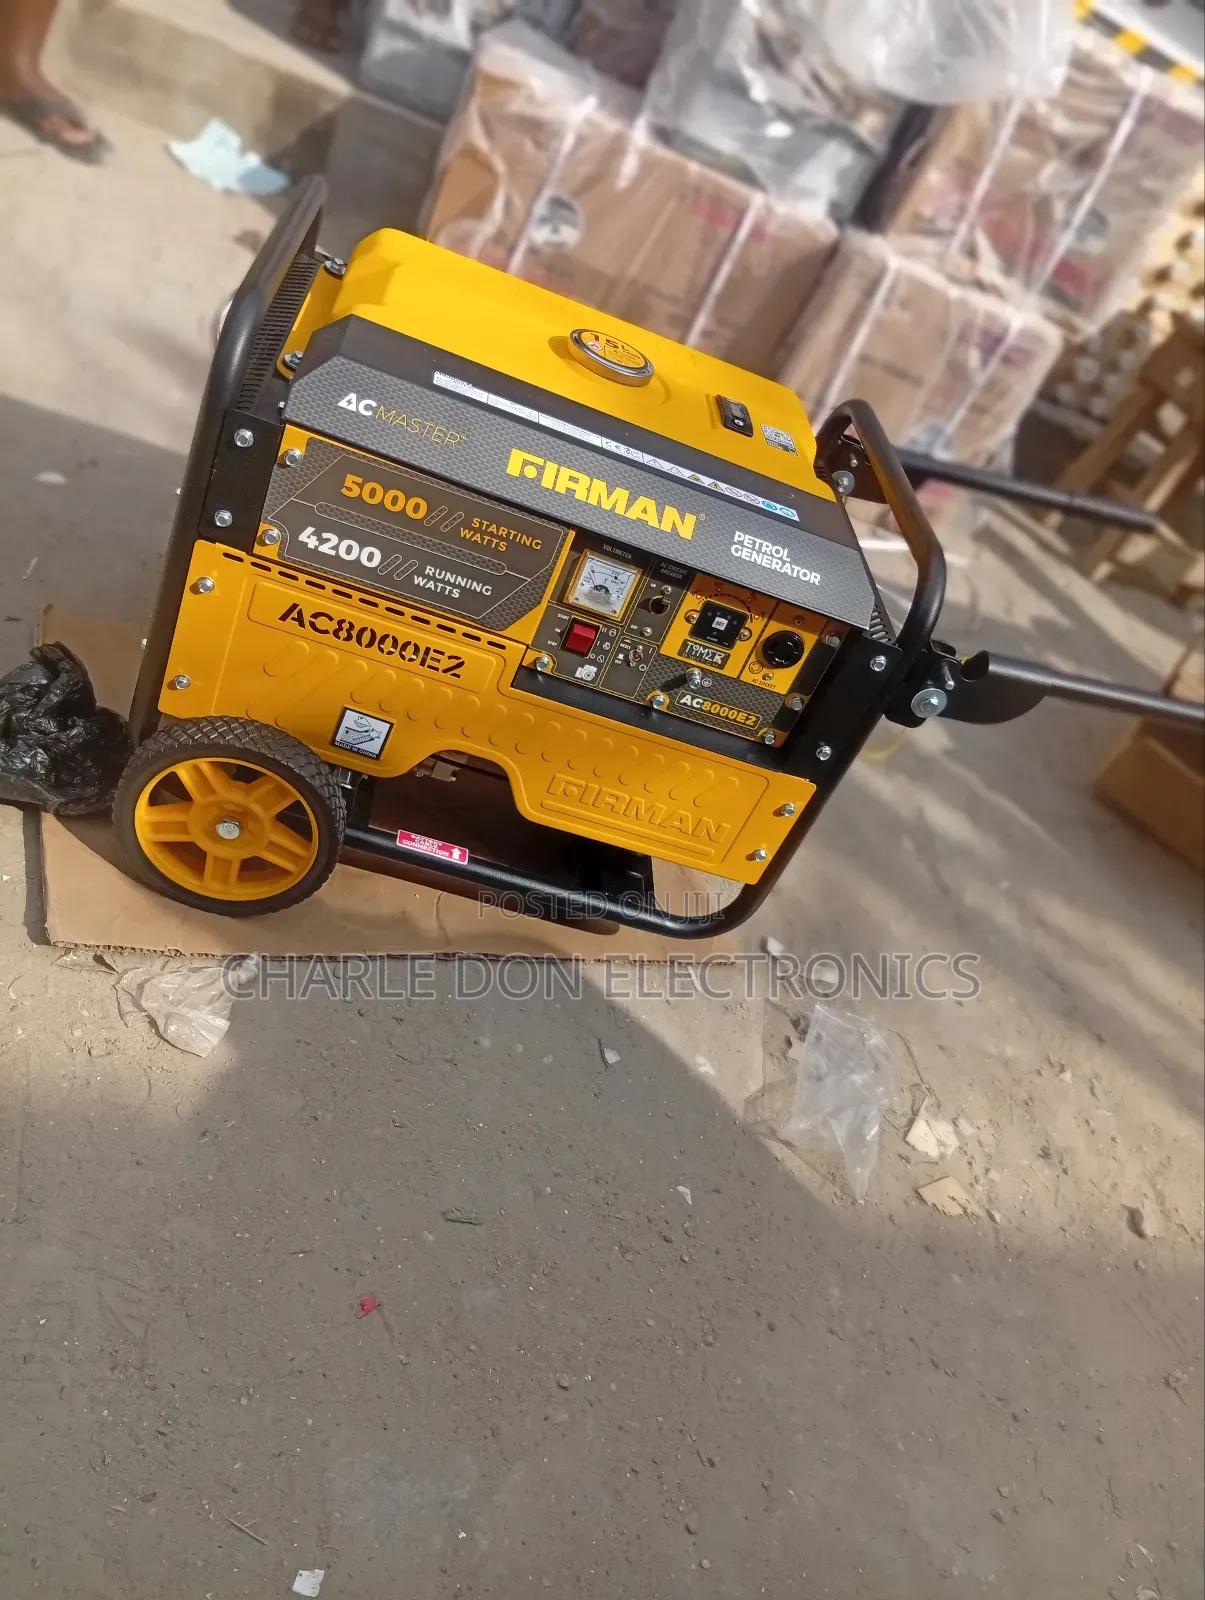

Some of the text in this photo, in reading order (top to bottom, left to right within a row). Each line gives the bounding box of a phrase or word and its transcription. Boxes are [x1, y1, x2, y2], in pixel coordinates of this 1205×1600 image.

[337, 392, 378, 416] AC
[340, 473, 428, 520] 5000
[506, 448, 697, 541] FIRMAN
[298, 526, 382, 568] 4200
[459, 527, 508, 552] WATTS
[471, 517, 543, 551] STARTING
[733, 530, 791, 562] PETROL
[425, 565, 493, 597] RUNNING
[730, 544, 821, 586] GENERATOR
[413, 575, 461, 599] WATTS
[278, 602, 466, 679] AC8000E2
[679, 694, 757, 726] AC8000E2
[334, 740, 352, 750] MADE
[358, 747, 377, 759] CHINA
[402, 839, 450, 857] CONNECTION
